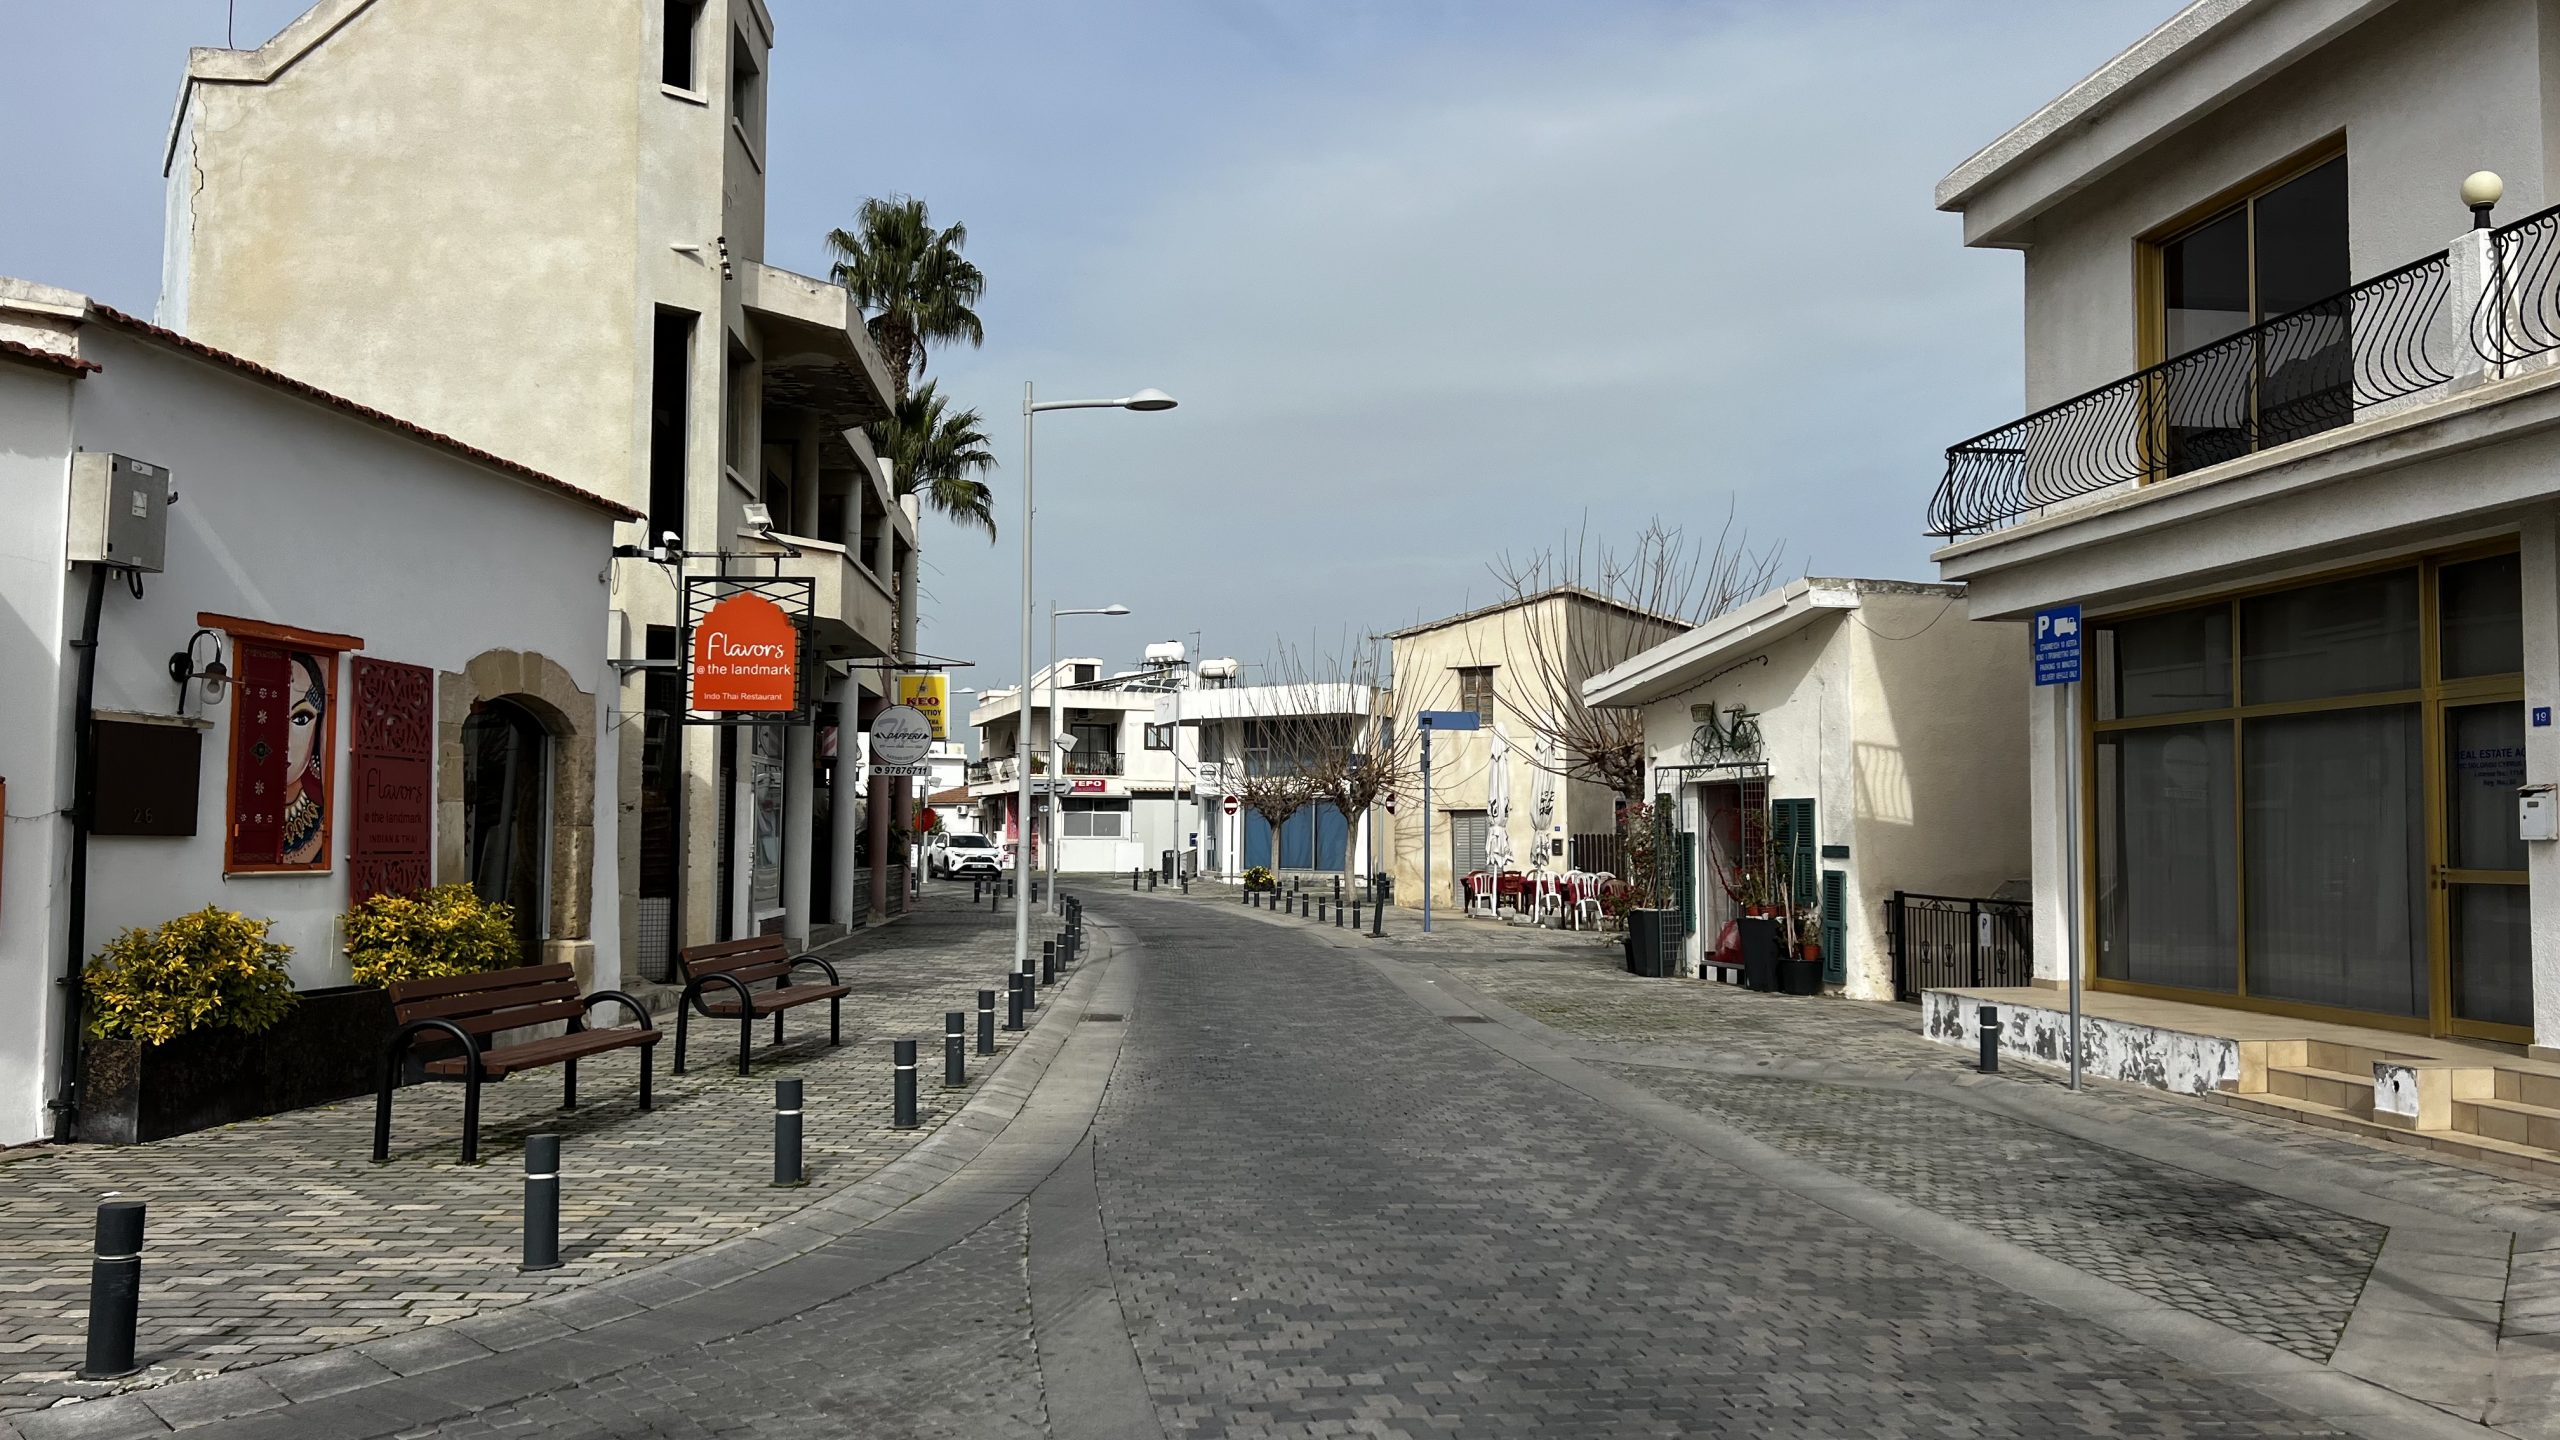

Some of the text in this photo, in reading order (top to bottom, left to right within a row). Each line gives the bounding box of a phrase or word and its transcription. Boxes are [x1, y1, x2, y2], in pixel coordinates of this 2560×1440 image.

[2038, 615, 2049, 639] P
[707, 632, 784, 660] Flavors
[707, 664, 727, 675] the
[731, 664, 791, 675] landmark
[704, 692, 782, 700] Indo Thai Restaurant
[2480, 748, 2512, 758] ESTATE
[884, 767, 928, 775] 97876711
[367, 767, 423, 804] Flavors
[372, 811, 384, 823] the
[387, 812, 422, 823] landmark
[369, 834, 394, 844] INDIAN
